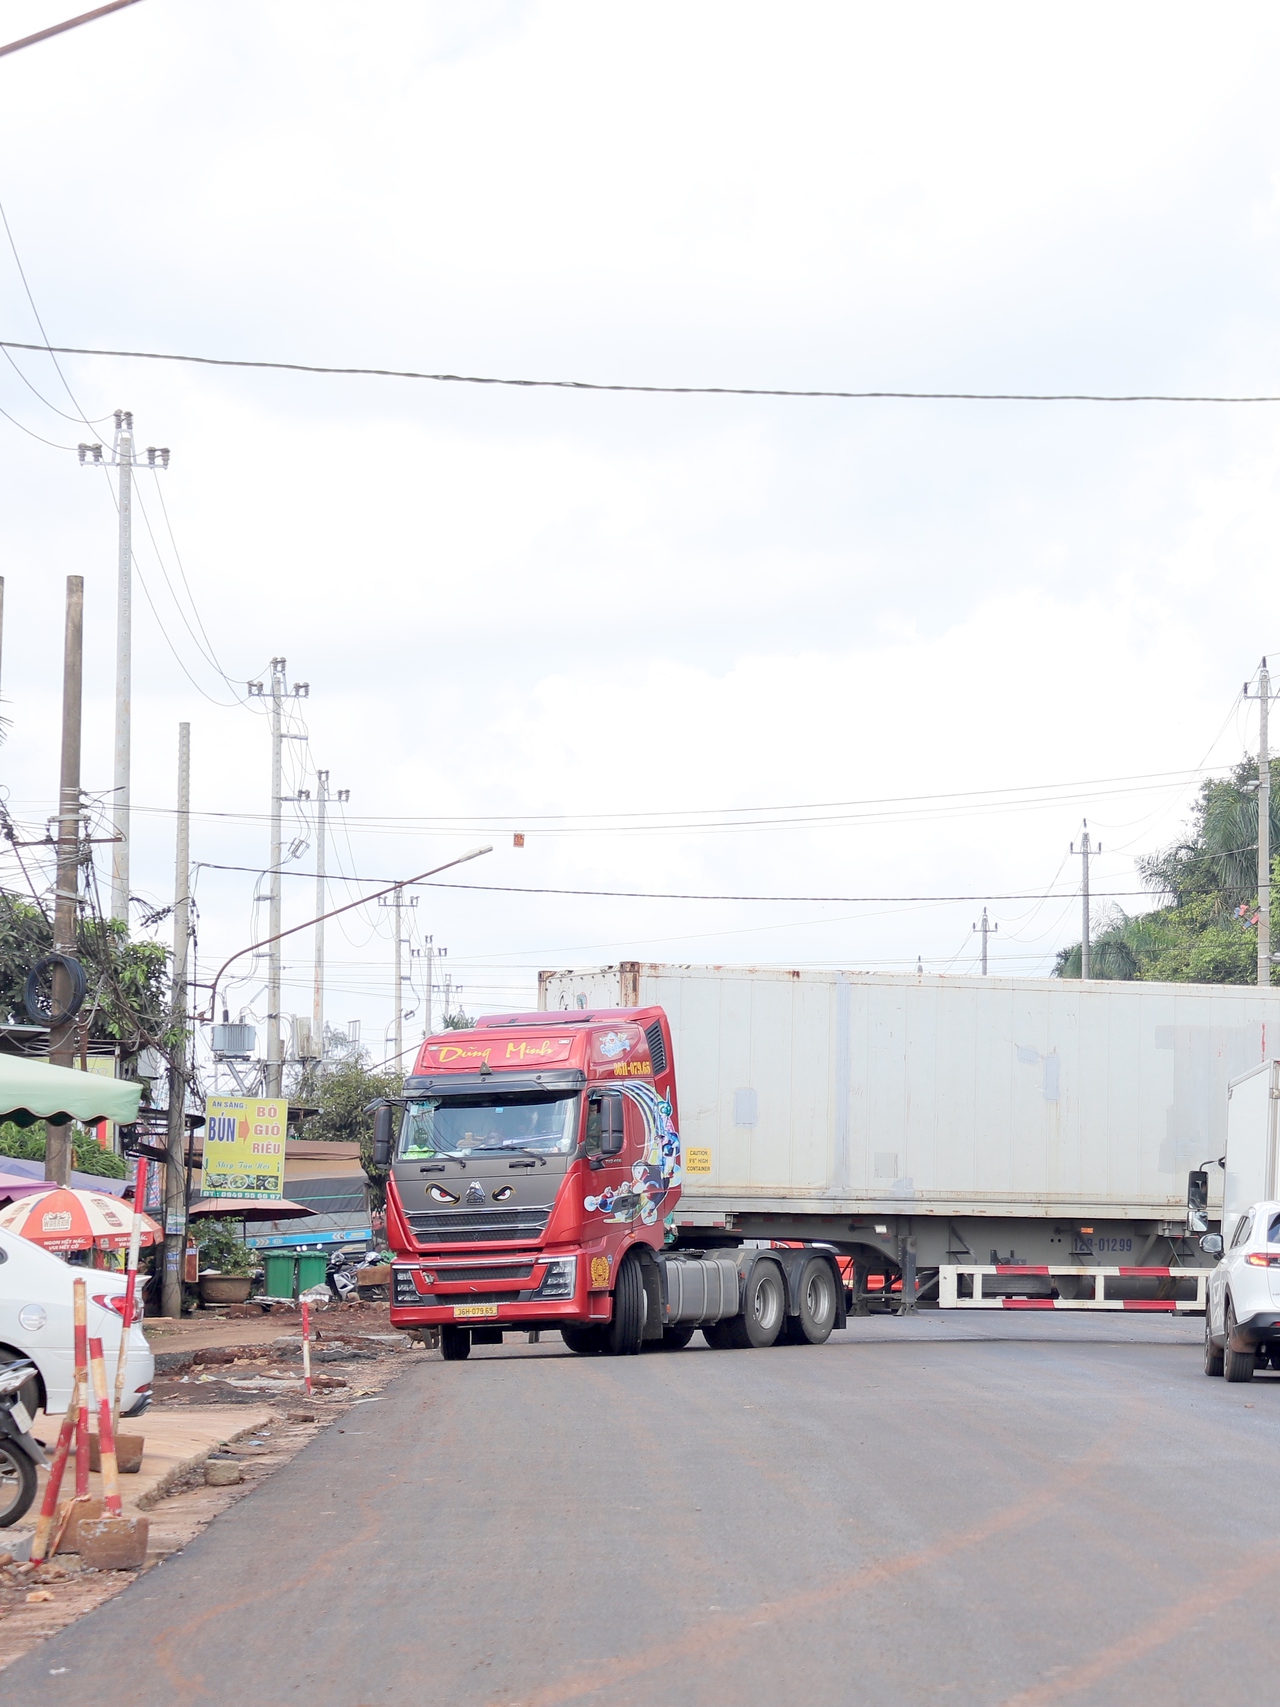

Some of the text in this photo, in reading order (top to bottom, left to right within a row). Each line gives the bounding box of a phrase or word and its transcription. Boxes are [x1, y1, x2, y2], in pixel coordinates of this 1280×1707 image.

[439, 1041, 553, 1067] Dũng Minh
[614, 1061, 650, 1076] 36H-079.65
[208, 1112, 236, 1142] BÚN
[252, 1141, 280, 1154] RIÊU
[457, 1307, 494, 1316] 36H-079.65
